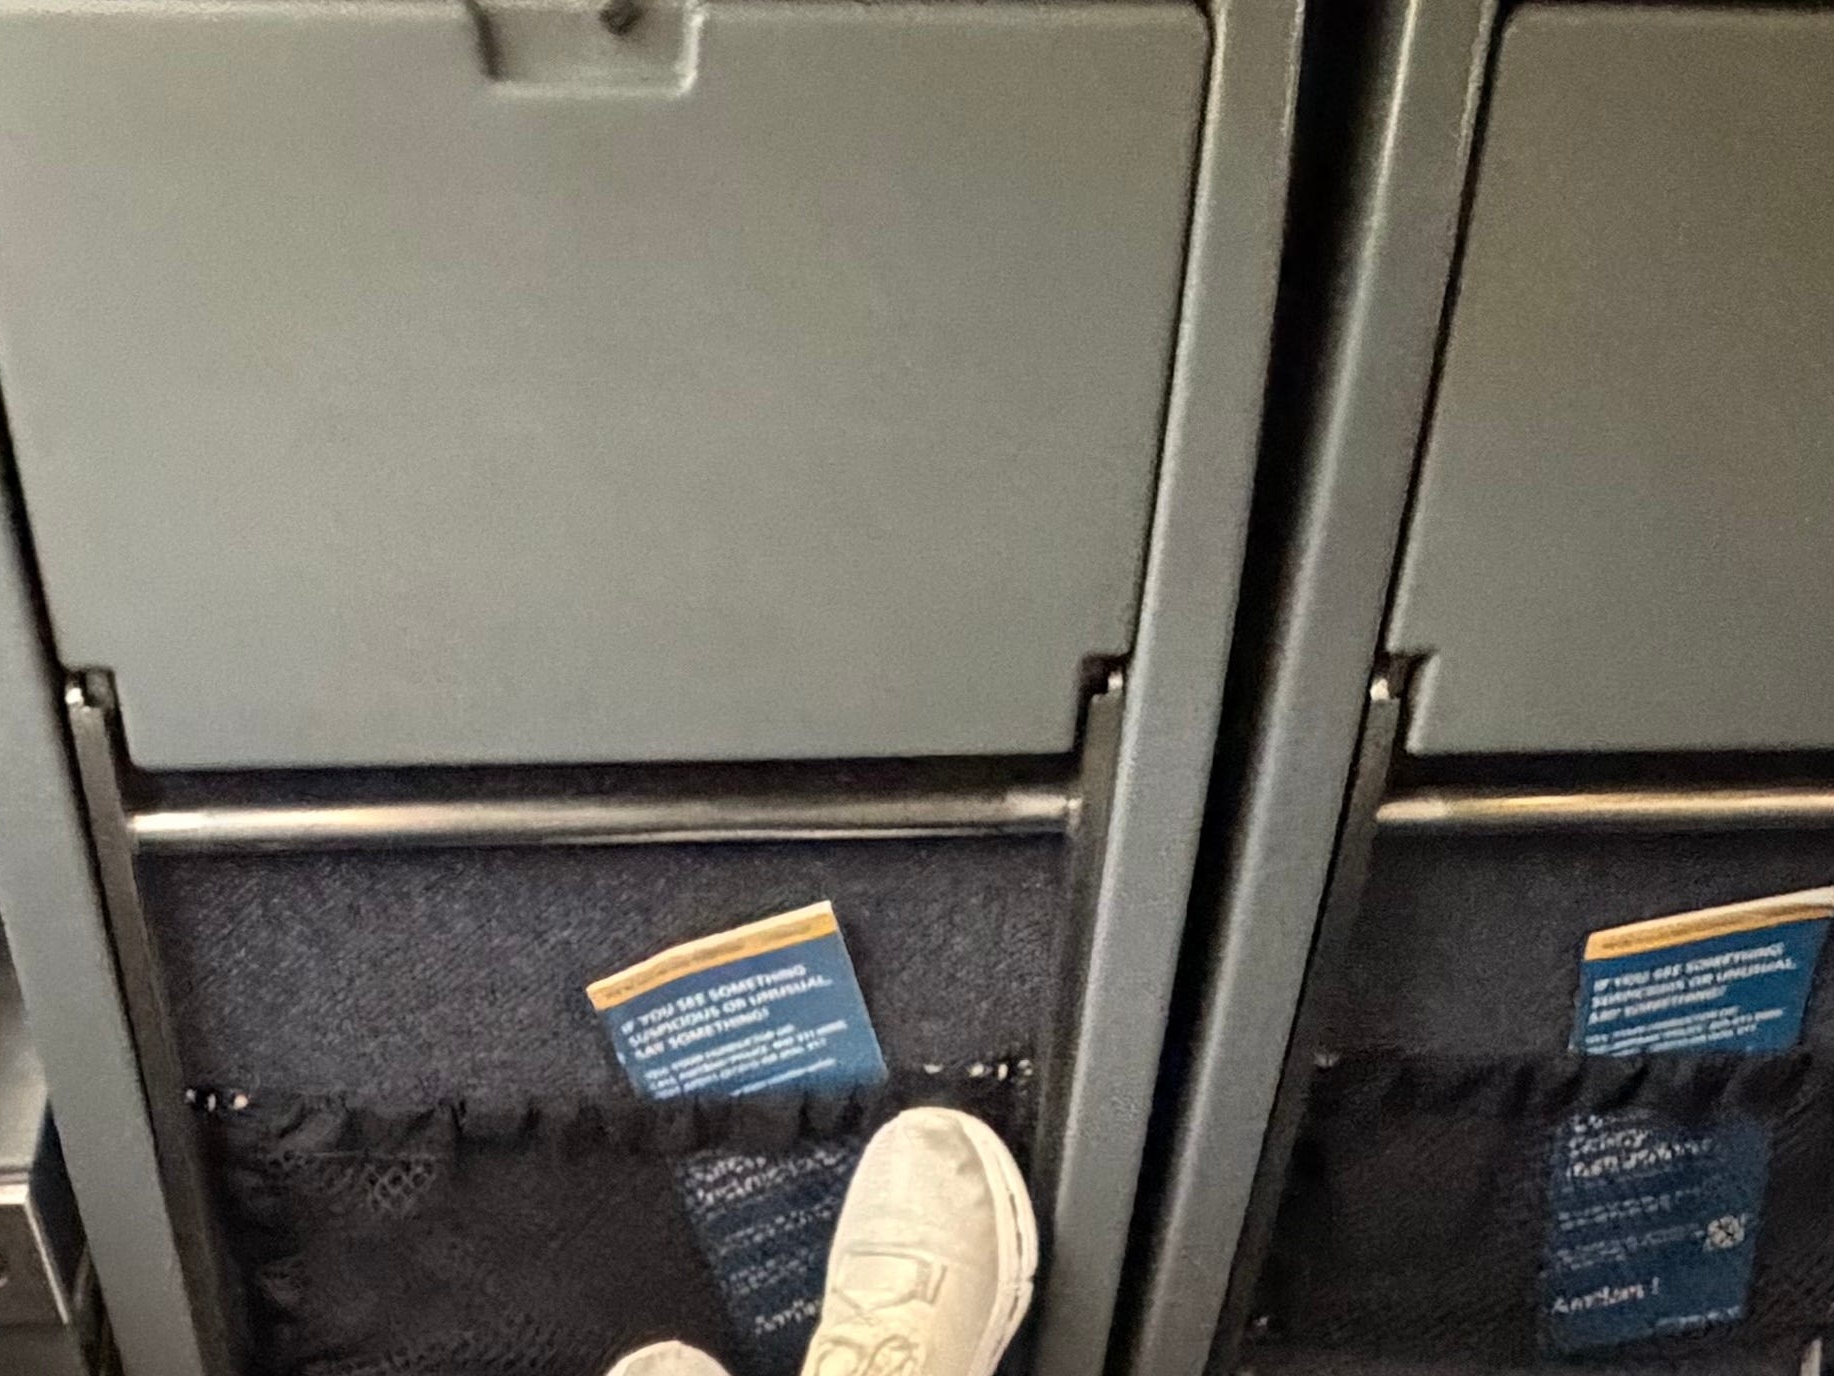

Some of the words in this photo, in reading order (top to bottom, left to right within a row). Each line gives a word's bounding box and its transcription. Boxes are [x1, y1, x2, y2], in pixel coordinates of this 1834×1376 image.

[628, 1006, 720, 1047] SUSPICIOUS
[722, 998, 747, 1014] OR
[638, 1004, 674, 1026] YOU
[676, 992, 705, 1013] SEE
[708, 964, 807, 1001] SOMETHING
